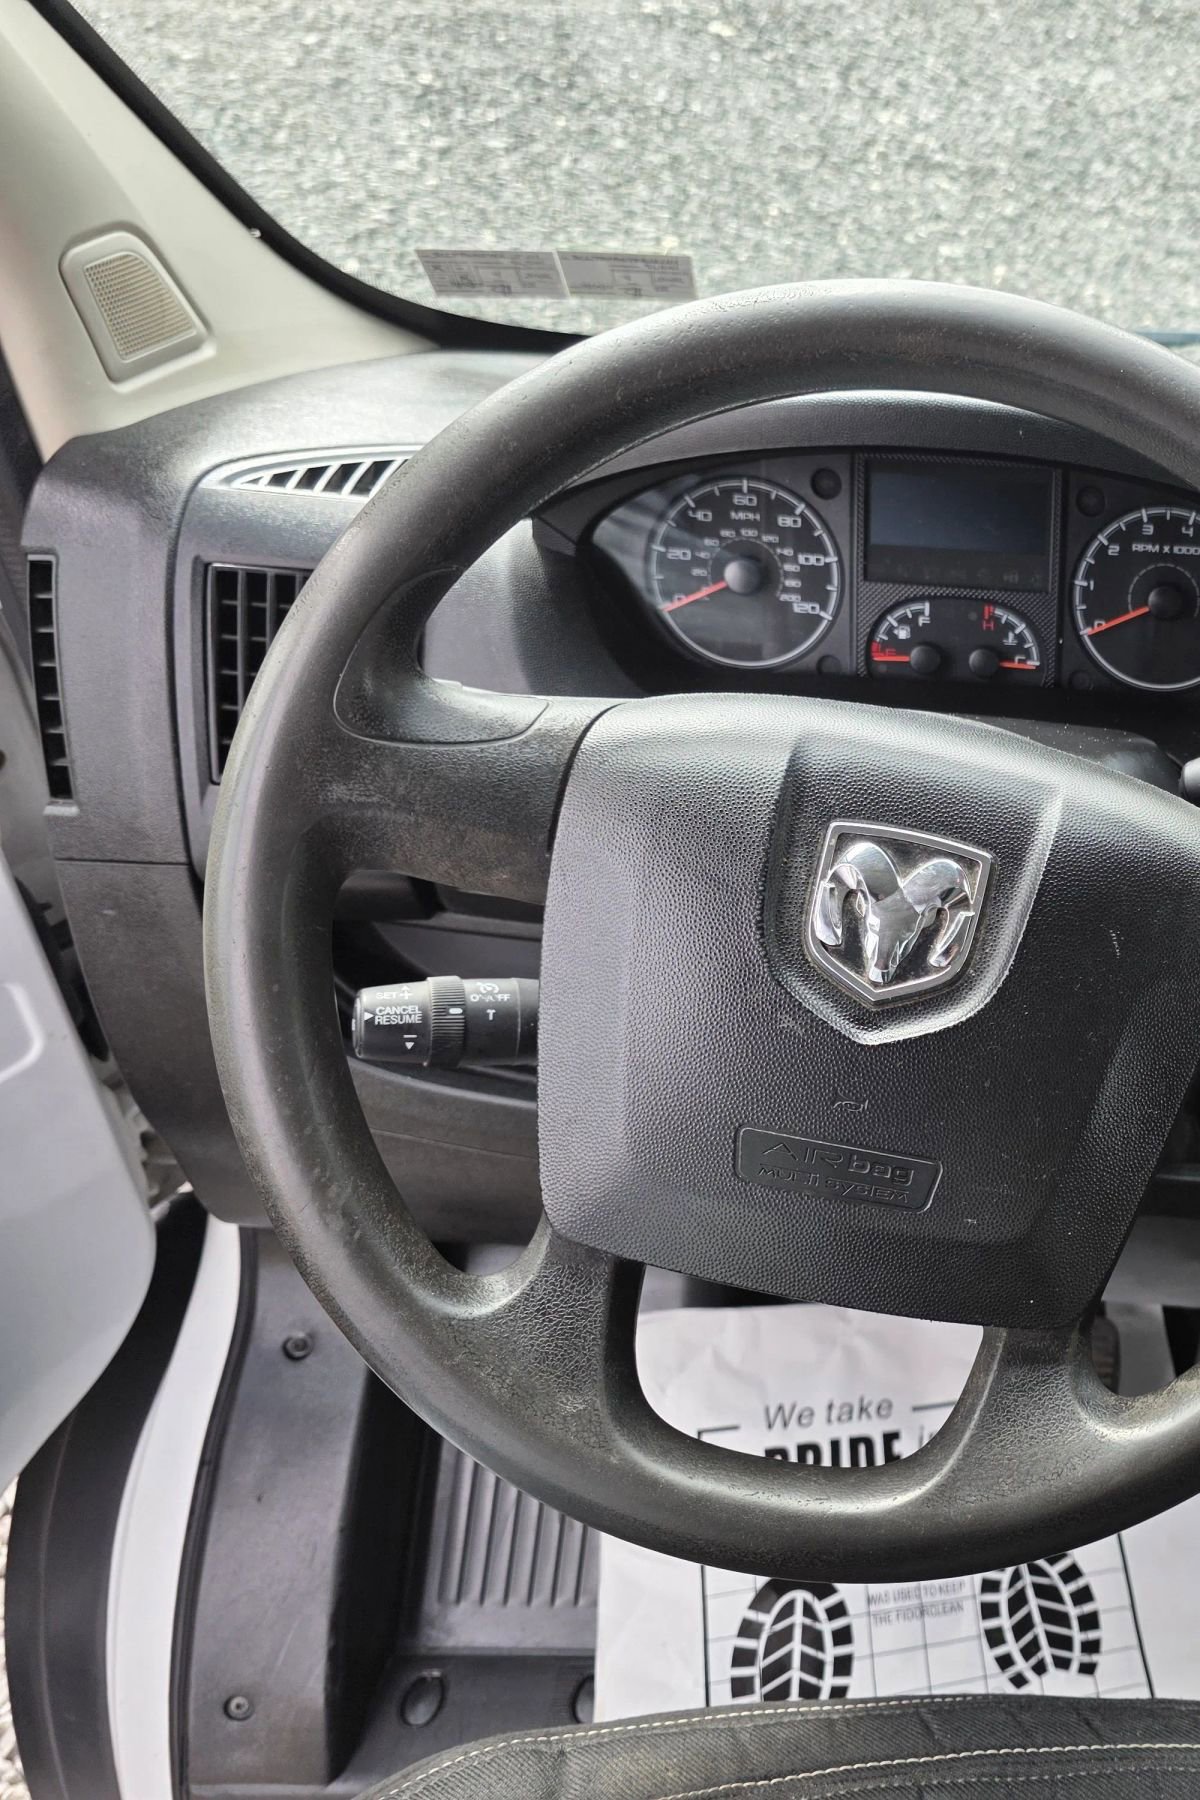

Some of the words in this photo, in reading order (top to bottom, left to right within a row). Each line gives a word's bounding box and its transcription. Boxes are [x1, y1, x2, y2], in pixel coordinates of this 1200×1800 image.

[732, 494, 757, 506] 60
[688, 511, 712, 521] 40
[730, 512, 760, 521] MPH
[777, 516, 801, 527] 80
[1142, 524, 1154, 535] 3
[1181, 526, 1194, 538] 4
[666, 549, 691, 560] 20
[1108, 544, 1120, 556] 2
[1132, 544, 1160, 554] RPM
[1173, 546, 1200, 555] 1000
[798, 554, 825, 566] 100
[1089, 580, 1095, 591] 1
[792, 602, 820, 614] 120
[918, 616, 931, 627] F
[982, 620, 995, 631] H
[375, 991, 398, 1000] SET
[375, 1005, 422, 1016] CANCEL
[374, 1014, 423, 1025] RESUME
[764, 1401, 815, 1430] We
[826, 1395, 893, 1425] take
[868, 1590, 891, 1605] WAS
[893, 1585, 921, 1601] USED
[923, 1583, 937, 1596] TO
[939, 1580, 966, 1594] KEEP
[873, 1613, 894, 1626] THE
